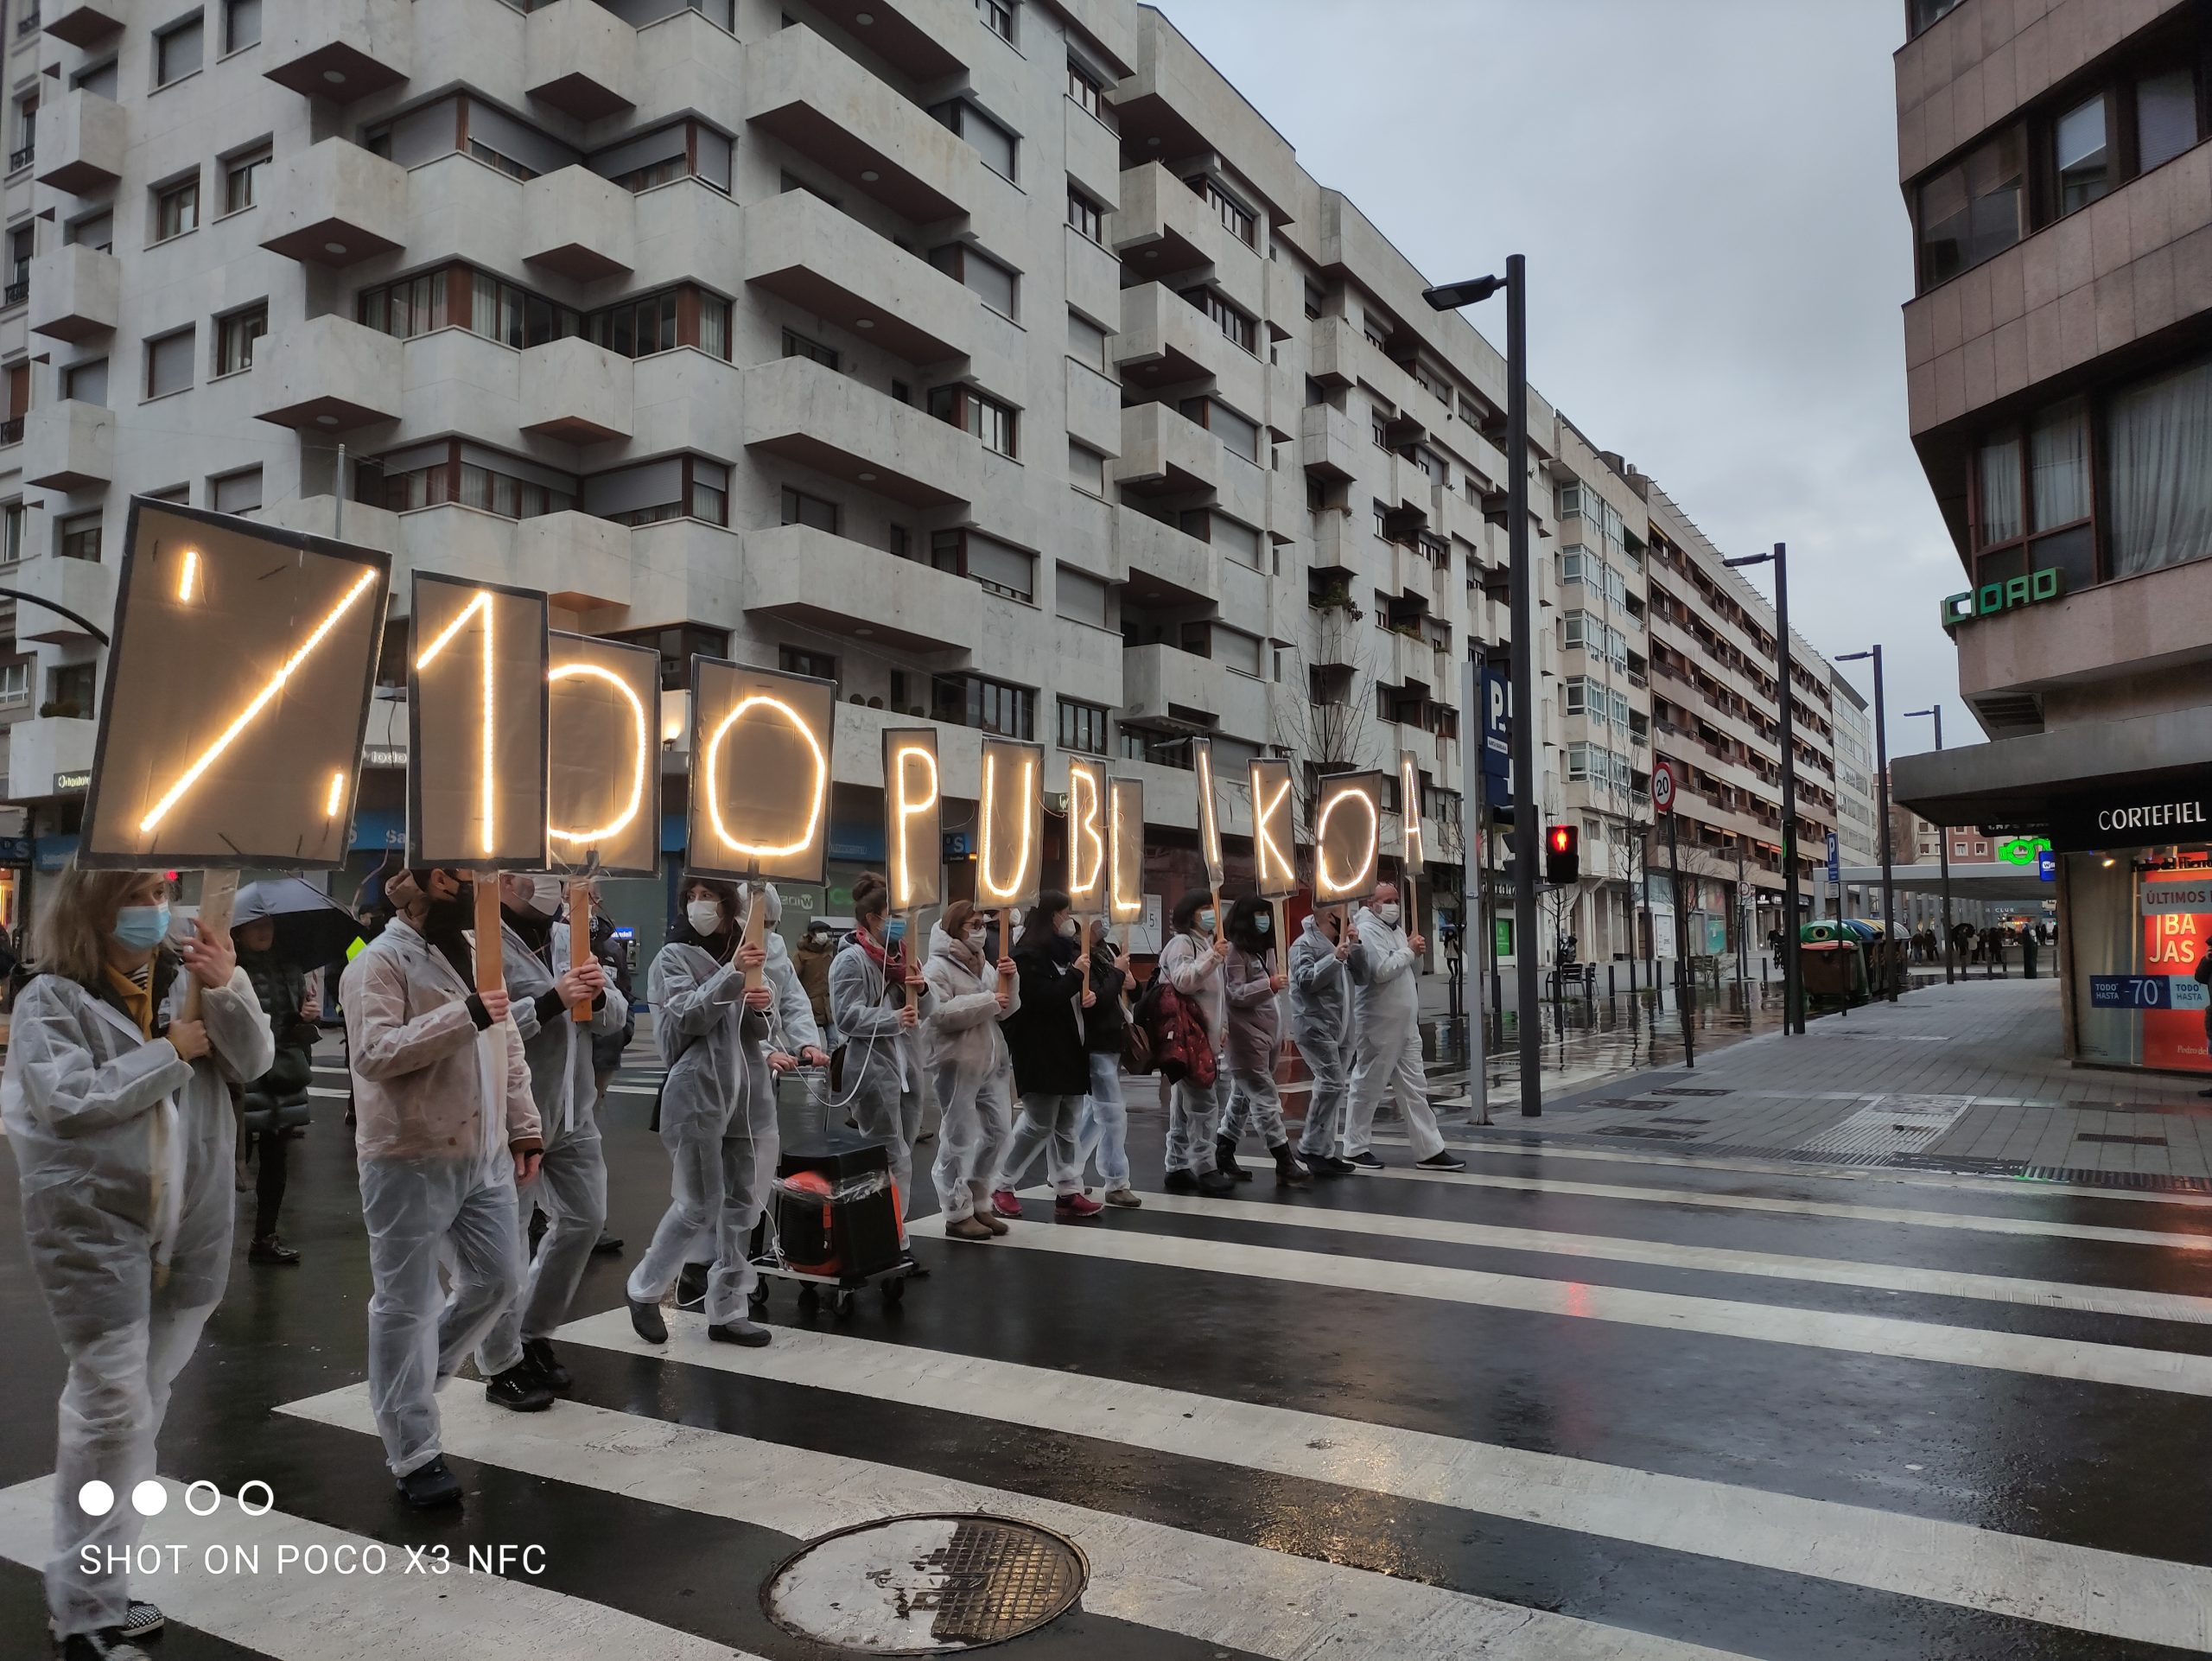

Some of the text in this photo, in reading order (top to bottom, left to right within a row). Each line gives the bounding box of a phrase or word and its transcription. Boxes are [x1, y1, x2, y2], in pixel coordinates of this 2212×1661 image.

[1656, 776, 1669, 797] 20
[2098, 801, 2207, 830] CORTEFIEL
[1828, 837, 1836, 862] P
[2146, 890, 2206, 905] ÚLTIMOS
[2096, 992, 2120, 1001] HASTA
[2177, 993, 2202, 1002] HASTA
[2177, 1045, 2209, 1055] Pedro del
